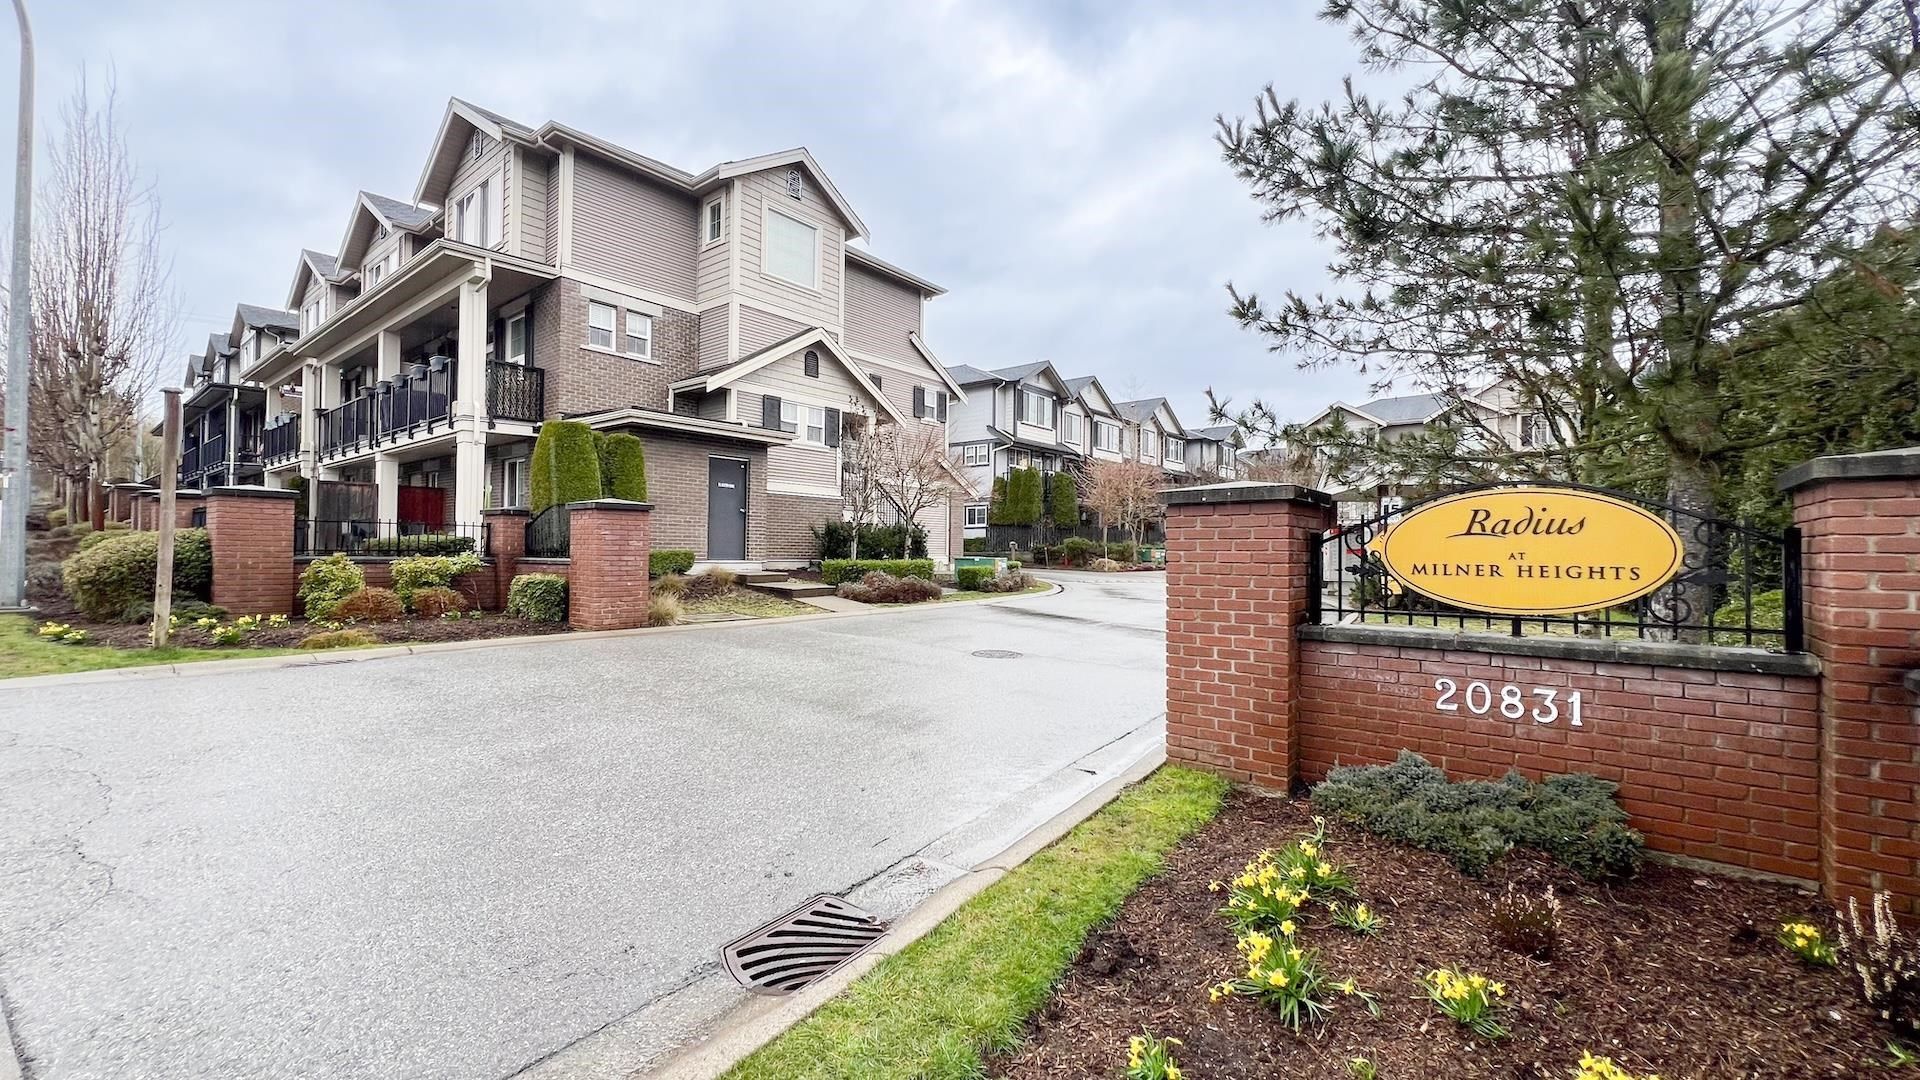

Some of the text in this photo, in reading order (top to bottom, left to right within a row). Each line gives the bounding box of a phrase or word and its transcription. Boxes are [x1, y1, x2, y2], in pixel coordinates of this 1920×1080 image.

[1446, 506, 1587, 539] Radius
[1508, 552, 1526, 561] AT
[1411, 563, 1641, 581] MILNER HEIGHTS
[1434, 678, 1583, 727] 20831
